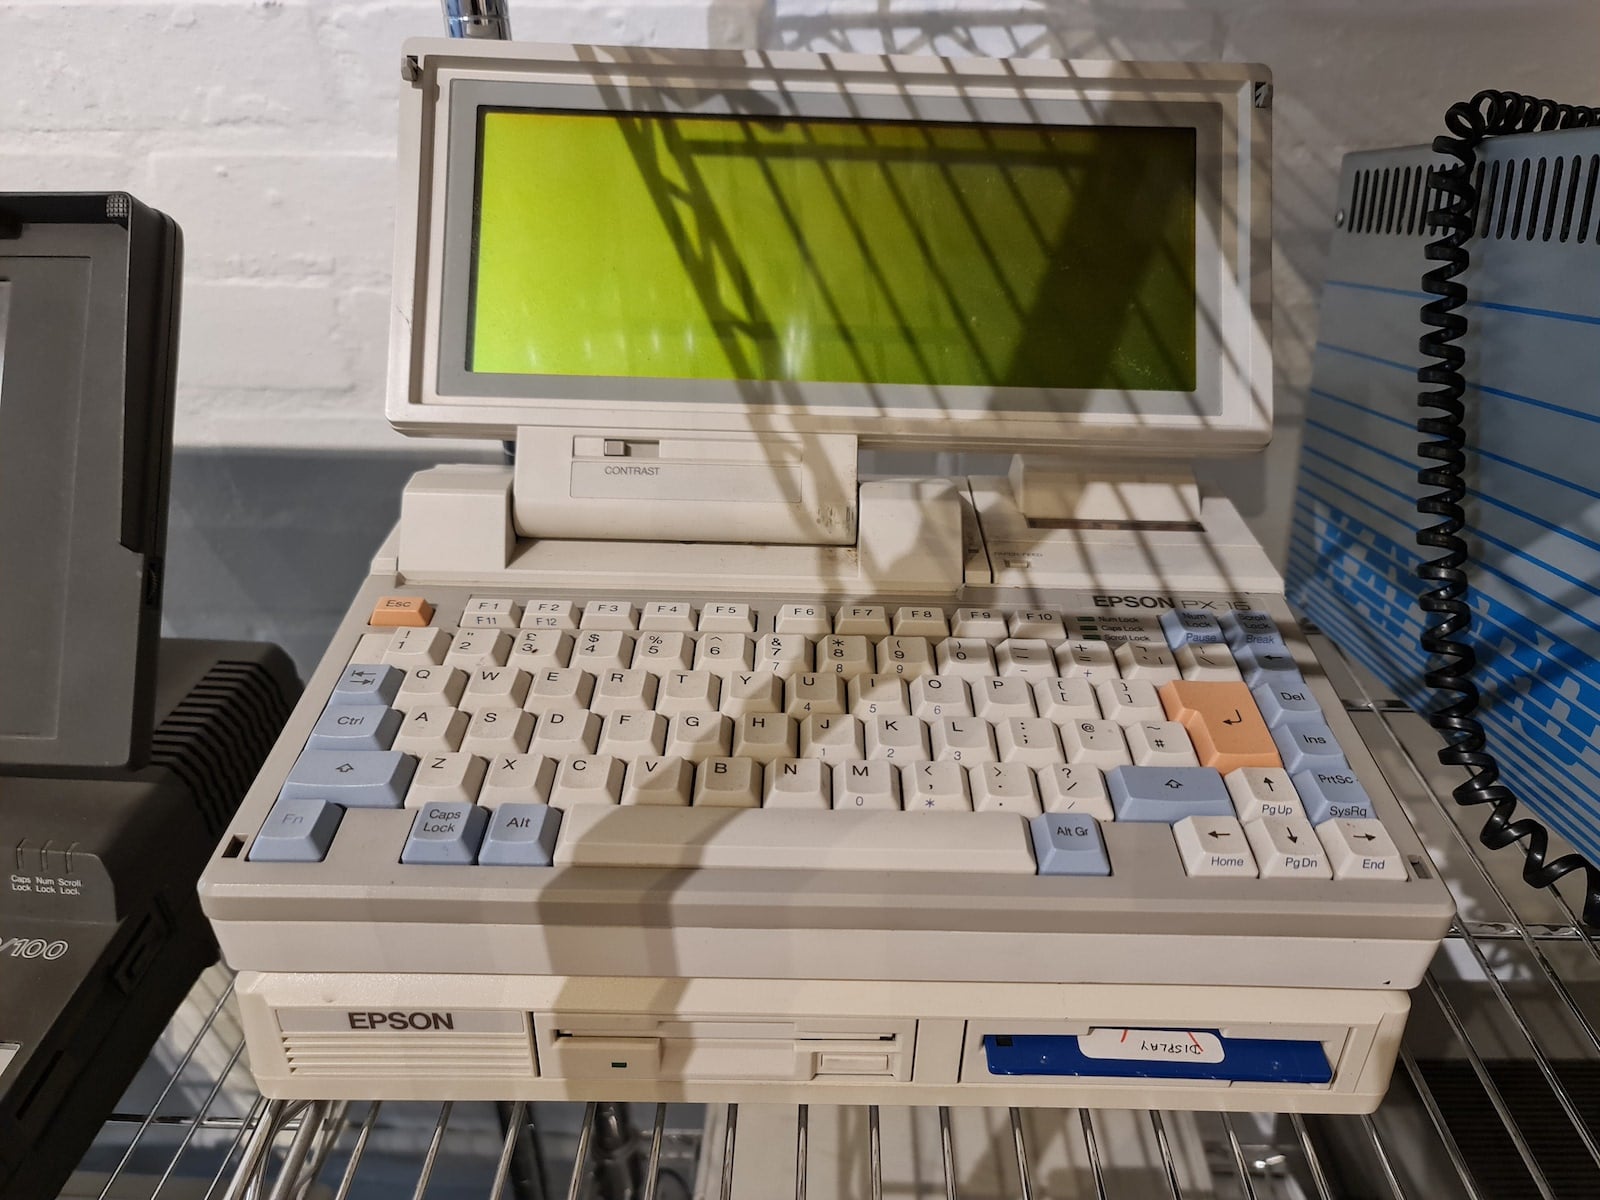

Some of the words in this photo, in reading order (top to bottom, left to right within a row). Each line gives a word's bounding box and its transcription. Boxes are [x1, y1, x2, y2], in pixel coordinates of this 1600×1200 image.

[604, 466, 661, 476] CONTRAST
[385, 599, 413, 608] Esc
[478, 601, 499, 610] F1
[1093, 595, 1176, 608] EPSON
[538, 602, 561, 612] F2
[597, 604, 619, 612] F3
[657, 605, 678, 613] F4
[716, 606, 737, 615] F5
[794, 608, 815, 616] F6
[852, 609, 873, 617] F7
[911, 610, 932, 618] F8
[1026, 613, 1053, 621] F10
[476, 616, 497, 625] F11
[535, 617, 557, 626] F12
[1186, 632, 1217, 642] Pause
[1246, 634, 1274, 644] Break
[397, 641, 406, 650] 1
[459, 641, 472, 650] 2
[522, 643, 533, 652] 3
[585, 644, 596, 653] 4
[648, 646, 659, 655] 5
[710, 646, 721, 656] 6
[772, 648, 783, 656] 7
[833, 649, 844, 658] 8
[894, 650, 905, 659] 9
[956, 651, 967, 661] 0
[772, 662, 781, 671] 7
[835, 663, 843, 673] 8
[896, 664, 904, 674] 9
[416, 670, 431, 680] Q
[482, 671, 500, 681] W
[546, 672, 560, 682] E
[611, 673, 624, 683] R
[676, 674, 689, 684] T
[739, 675, 752, 685] Y
[802, 676, 815, 686] U
[928, 679, 942, 689] O
[993, 680, 1004, 690] P
[1281, 691, 1306, 702] Del
[803, 702, 812, 712] 4
[868, 704, 877, 713] 5
[933, 705, 942, 715] 6
[337, 716, 365, 726] Ctrl
[415, 711, 429, 722] A
[483, 712, 497, 723] S
[550, 713, 565, 724] D
[619, 715, 632, 725] F
[685, 716, 700, 727] G
[752, 718, 765, 728] H
[820, 719, 830, 729] J
[885, 720, 899, 731] K
[952, 722, 964, 732] L
[1303, 734, 1327, 745] Ins
[821, 748, 826, 756] 1
[886, 748, 895, 758] 2
[953, 751, 962, 761] 3
[431, 758, 447, 769] Z
[502, 759, 518, 770] X
[572, 760, 587, 771] C
[644, 761, 658, 772] V
[714, 763, 728, 774] B
[784, 764, 798, 775] N
[852, 765, 869, 777] M
[1318, 773, 1354, 785] PrtSc
[855, 796, 864, 807] 0
[429, 808, 461, 821] Caps
[1330, 806, 1367, 819] SysRq
[281, 813, 304, 825] Fn
[506, 817, 531, 829] Alt
[423, 822, 456, 833] Lock
[1056, 826, 1074, 837] Alt
[1075, 826, 1089, 837] Gr
[1211, 856, 1244, 867] Home
[1362, 859, 1385, 870] End
[10, 874, 31, 884] Caps
[35, 876, 55, 885] Num
[58, 878, 82, 887] Scroll
[12, 883, 32, 892] Lock
[36, 886, 56, 894] Lock
[0, 937, 69, 960] /100
[347, 1012, 454, 1030] EPSON
[1141, 1040, 1201, 1055] DISPLAY
